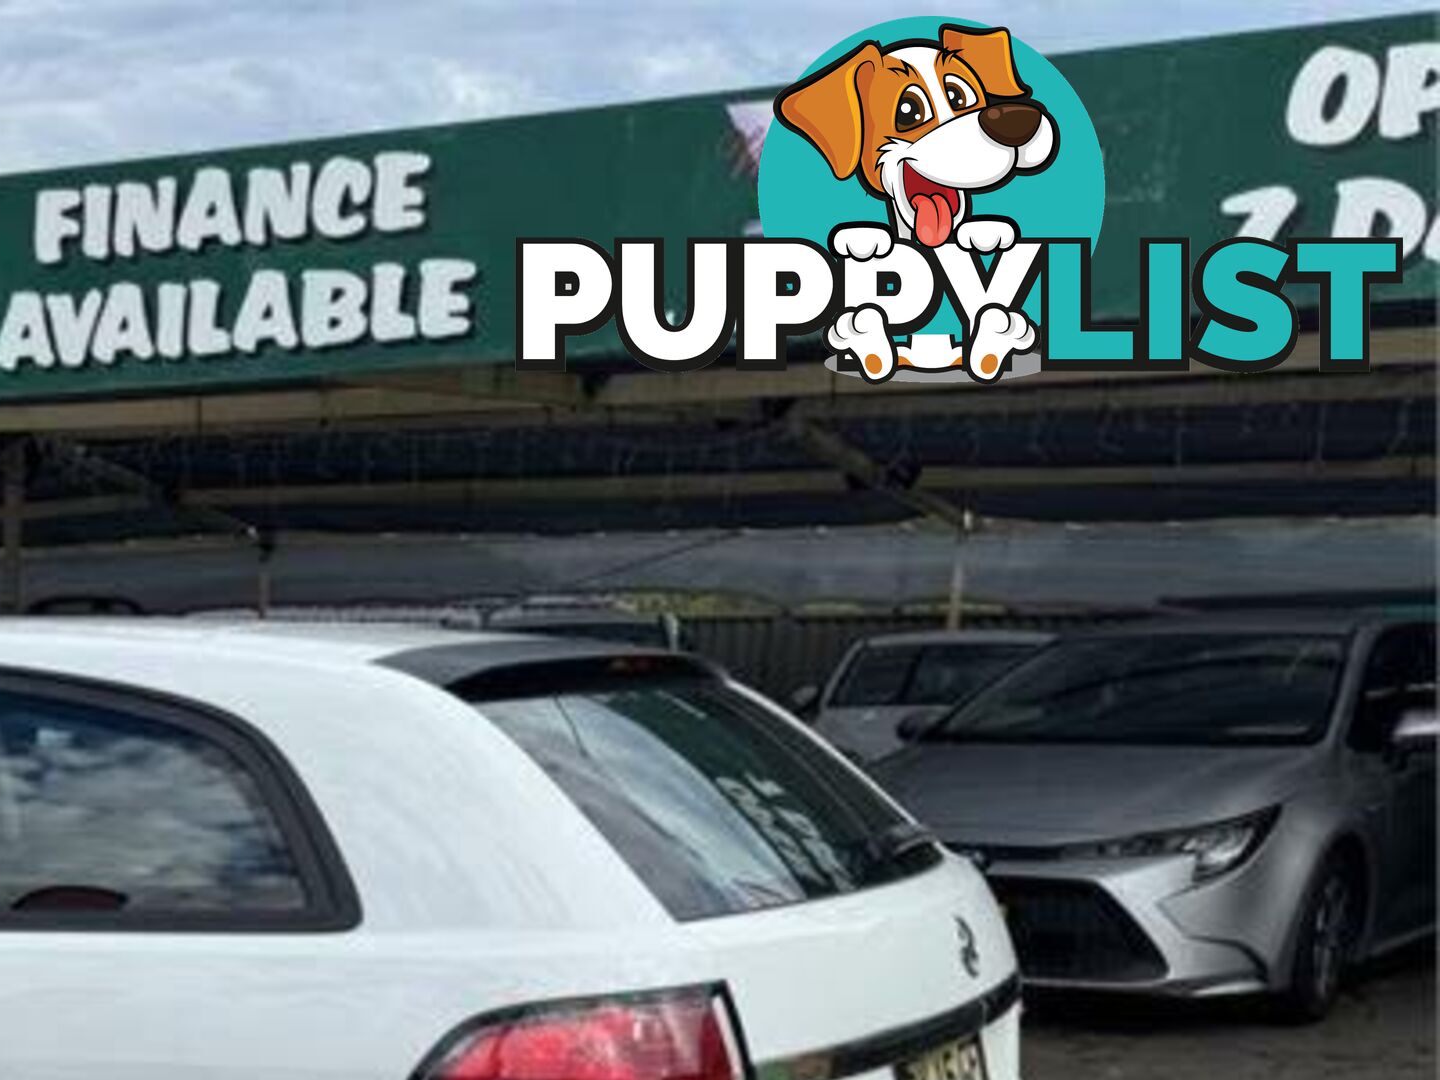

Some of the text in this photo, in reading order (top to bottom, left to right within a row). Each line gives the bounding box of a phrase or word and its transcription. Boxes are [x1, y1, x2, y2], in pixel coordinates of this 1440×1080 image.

[1286, 41, 1439, 146] OP
[34, 151, 431, 264] FINANCE
[1331, 176, 1439, 262] D
